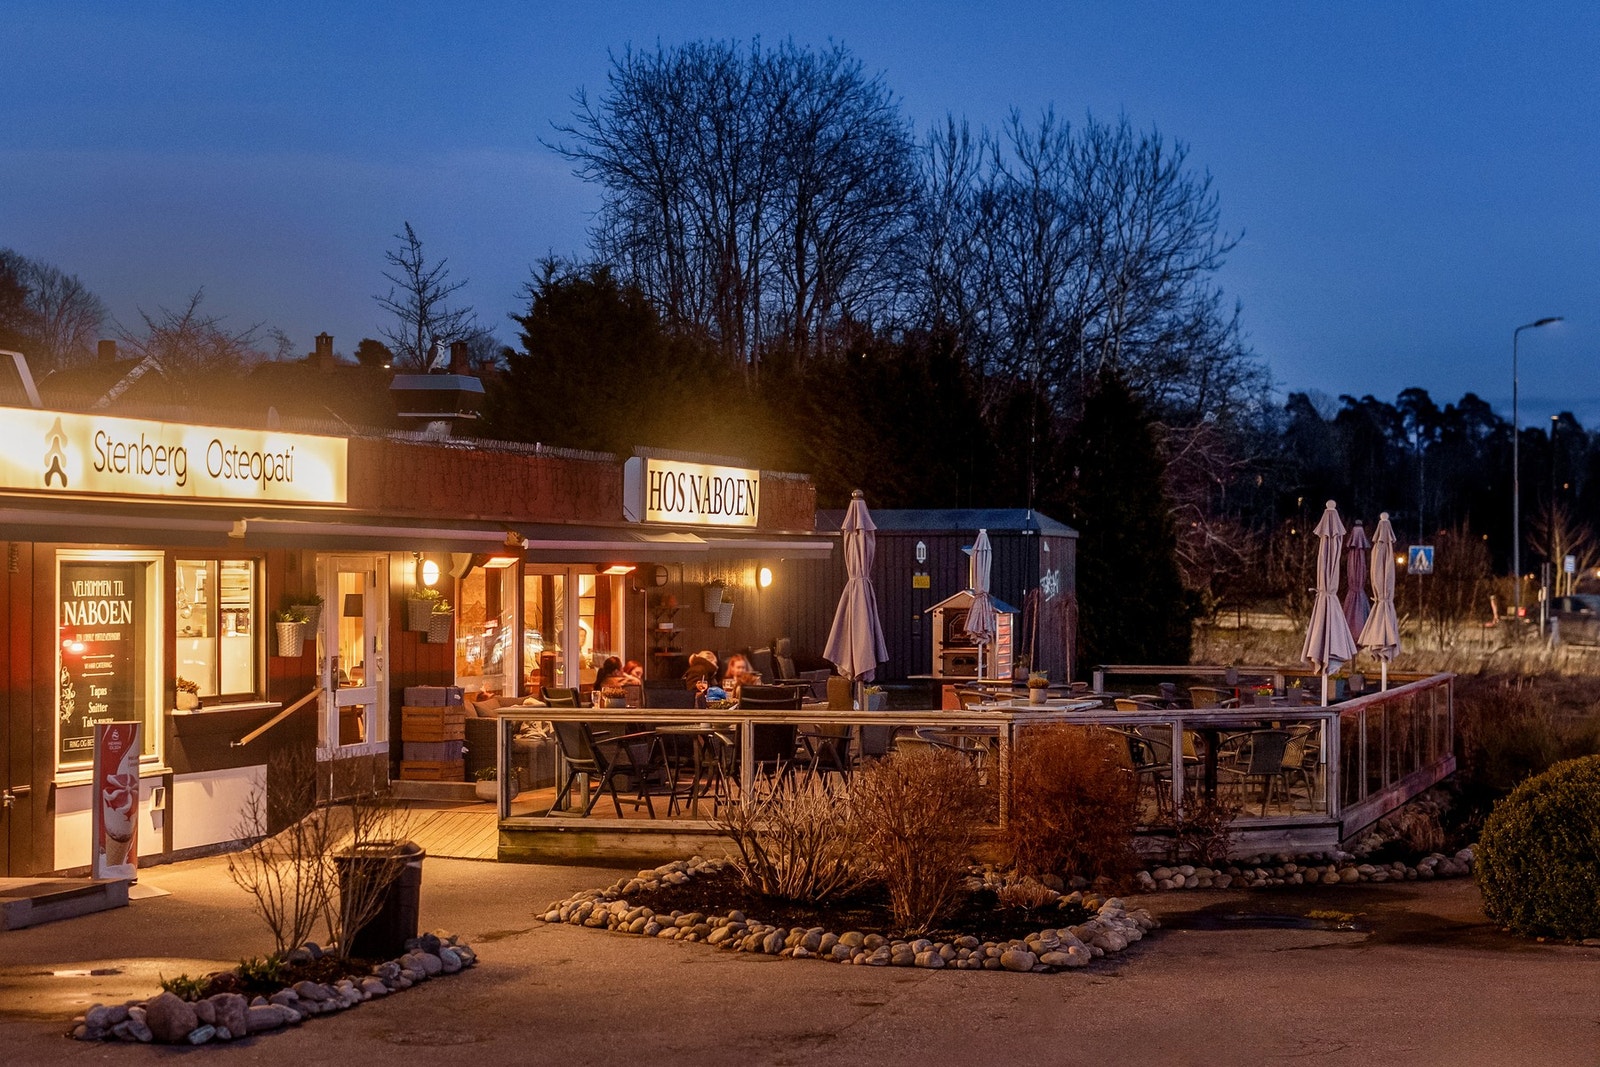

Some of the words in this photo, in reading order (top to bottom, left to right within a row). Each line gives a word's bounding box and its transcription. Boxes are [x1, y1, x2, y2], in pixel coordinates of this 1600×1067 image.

[93, 430, 188, 487] Stenberg
[206, 438, 295, 491] Osteopati
[648, 470, 686, 513] HOS
[689, 475, 758, 517] NABOEN
[72, 580, 112, 597] VELKOMMEN
[113, 580, 125, 597] TIL
[64, 600, 133, 626] NABOEN
[90, 684, 108, 699] Tapas
[88, 701, 108, 714] Snitter
